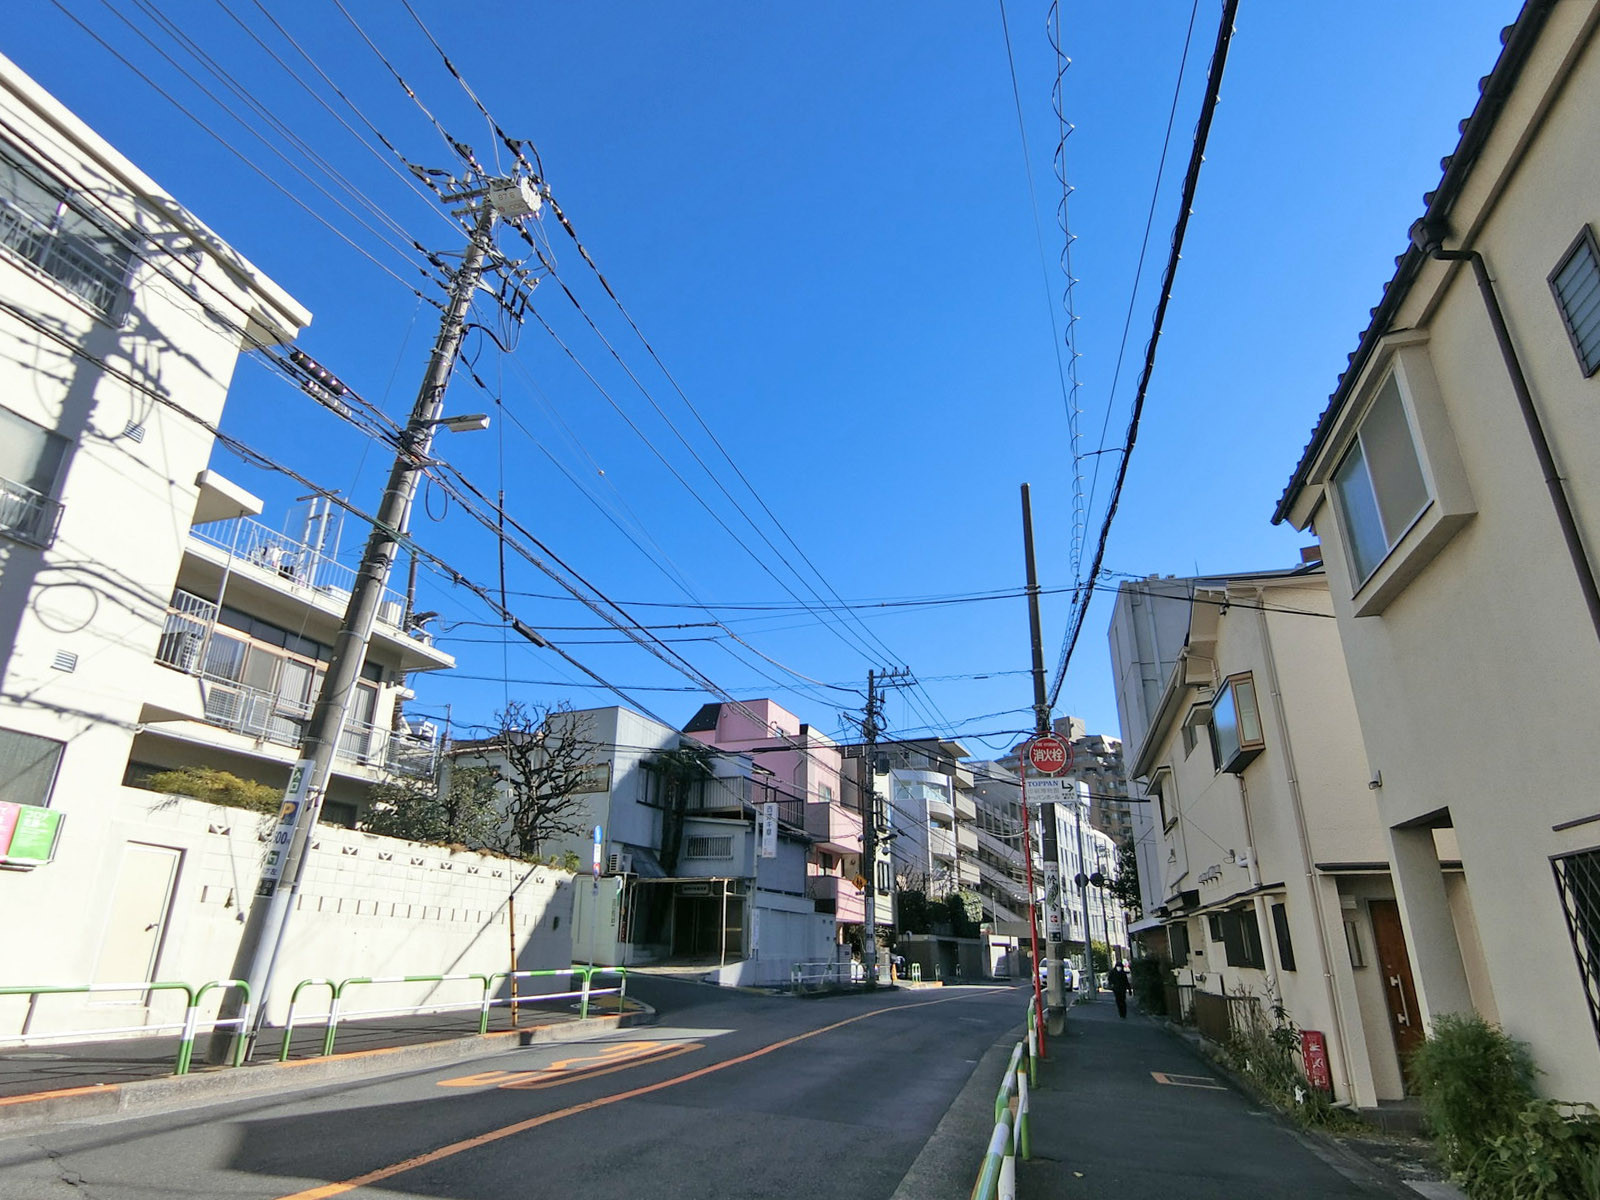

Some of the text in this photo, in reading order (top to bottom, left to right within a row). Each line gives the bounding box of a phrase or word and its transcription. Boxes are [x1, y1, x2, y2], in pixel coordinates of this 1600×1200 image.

[1033, 748, 1063, 762] 消火栓
[290, 767, 303, 791] 入口
[280, 802, 296, 820] P
